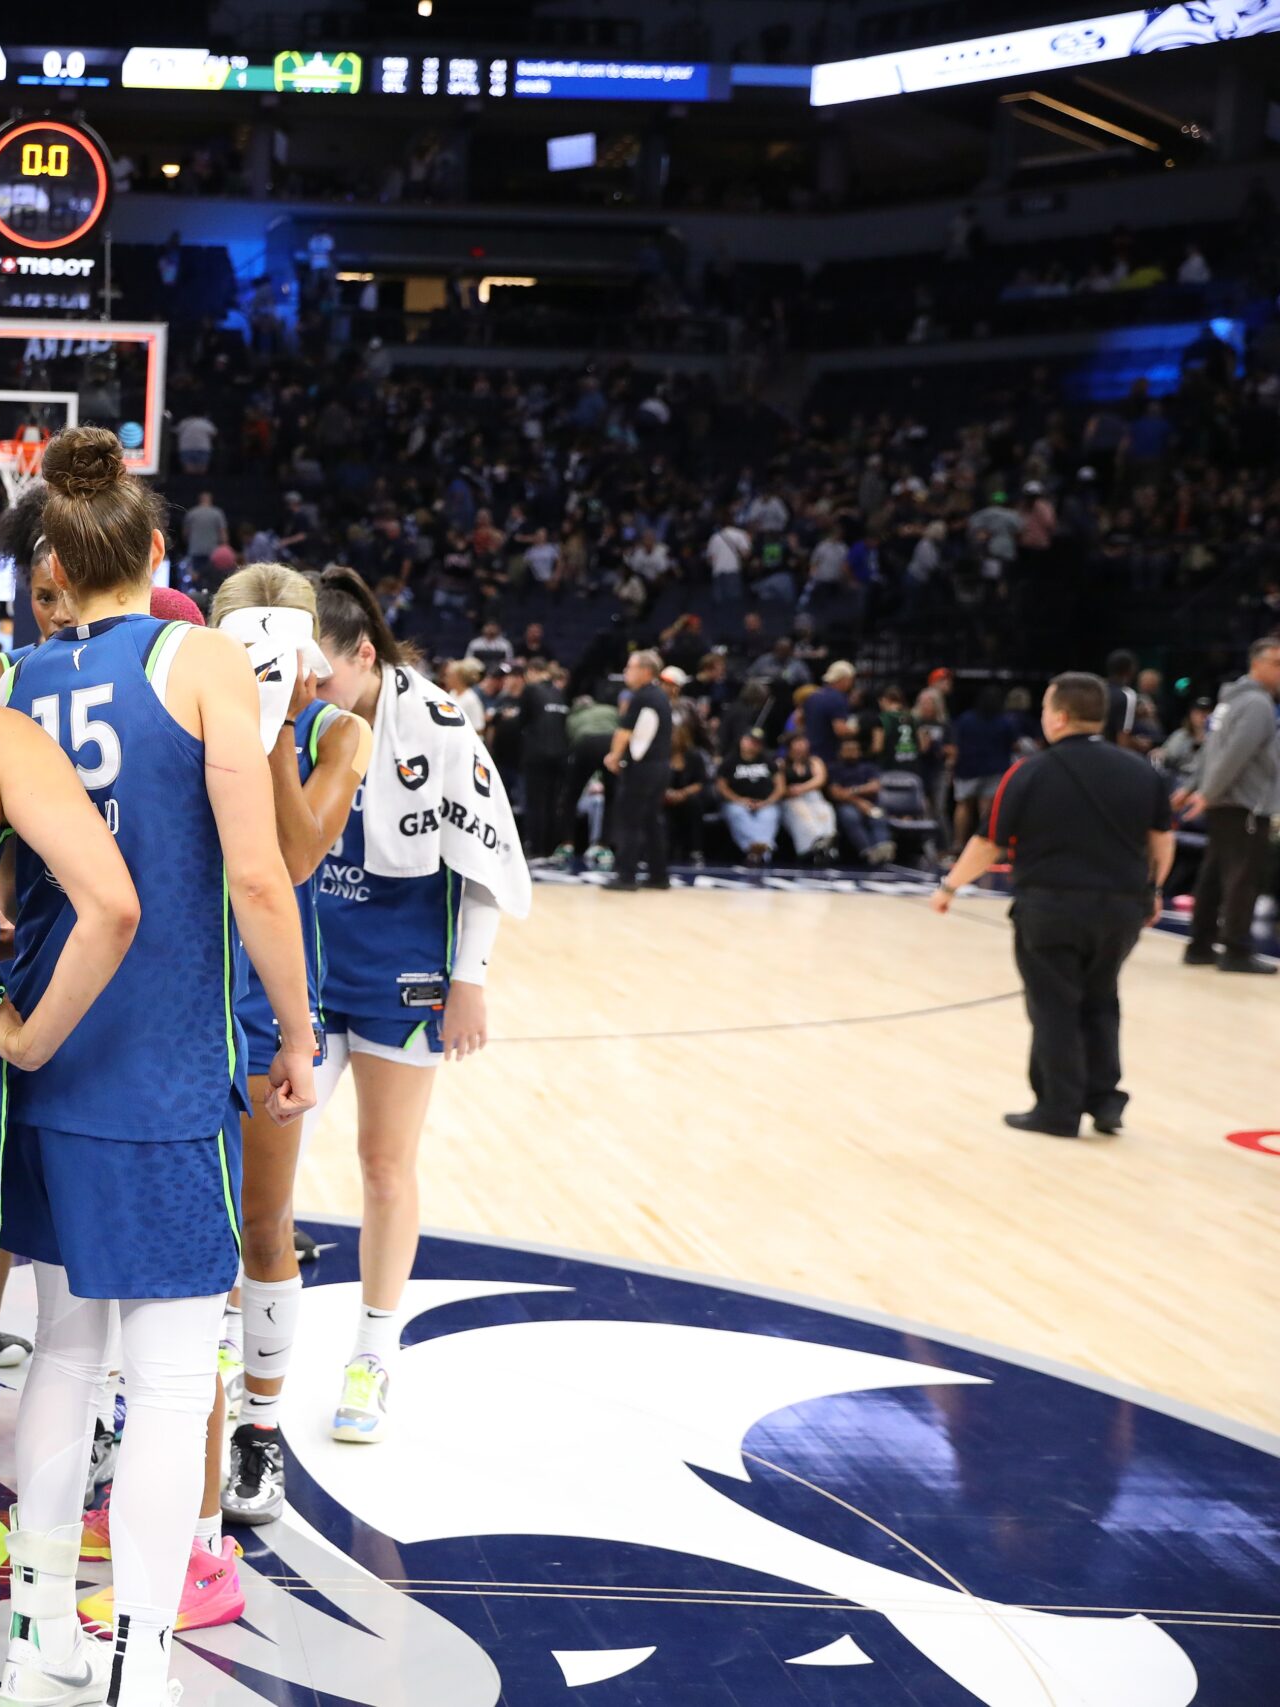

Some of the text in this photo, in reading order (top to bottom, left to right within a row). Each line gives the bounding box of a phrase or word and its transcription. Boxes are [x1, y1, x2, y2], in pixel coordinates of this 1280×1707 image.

[42, 50, 86, 79] 0.0
[22, 144, 69, 177] 0.0
[16, 257, 96, 277] TISSOT
[31, 682, 122, 790] 15
[322, 863, 365, 884] AYO
[320, 880, 371, 902] LINIC
